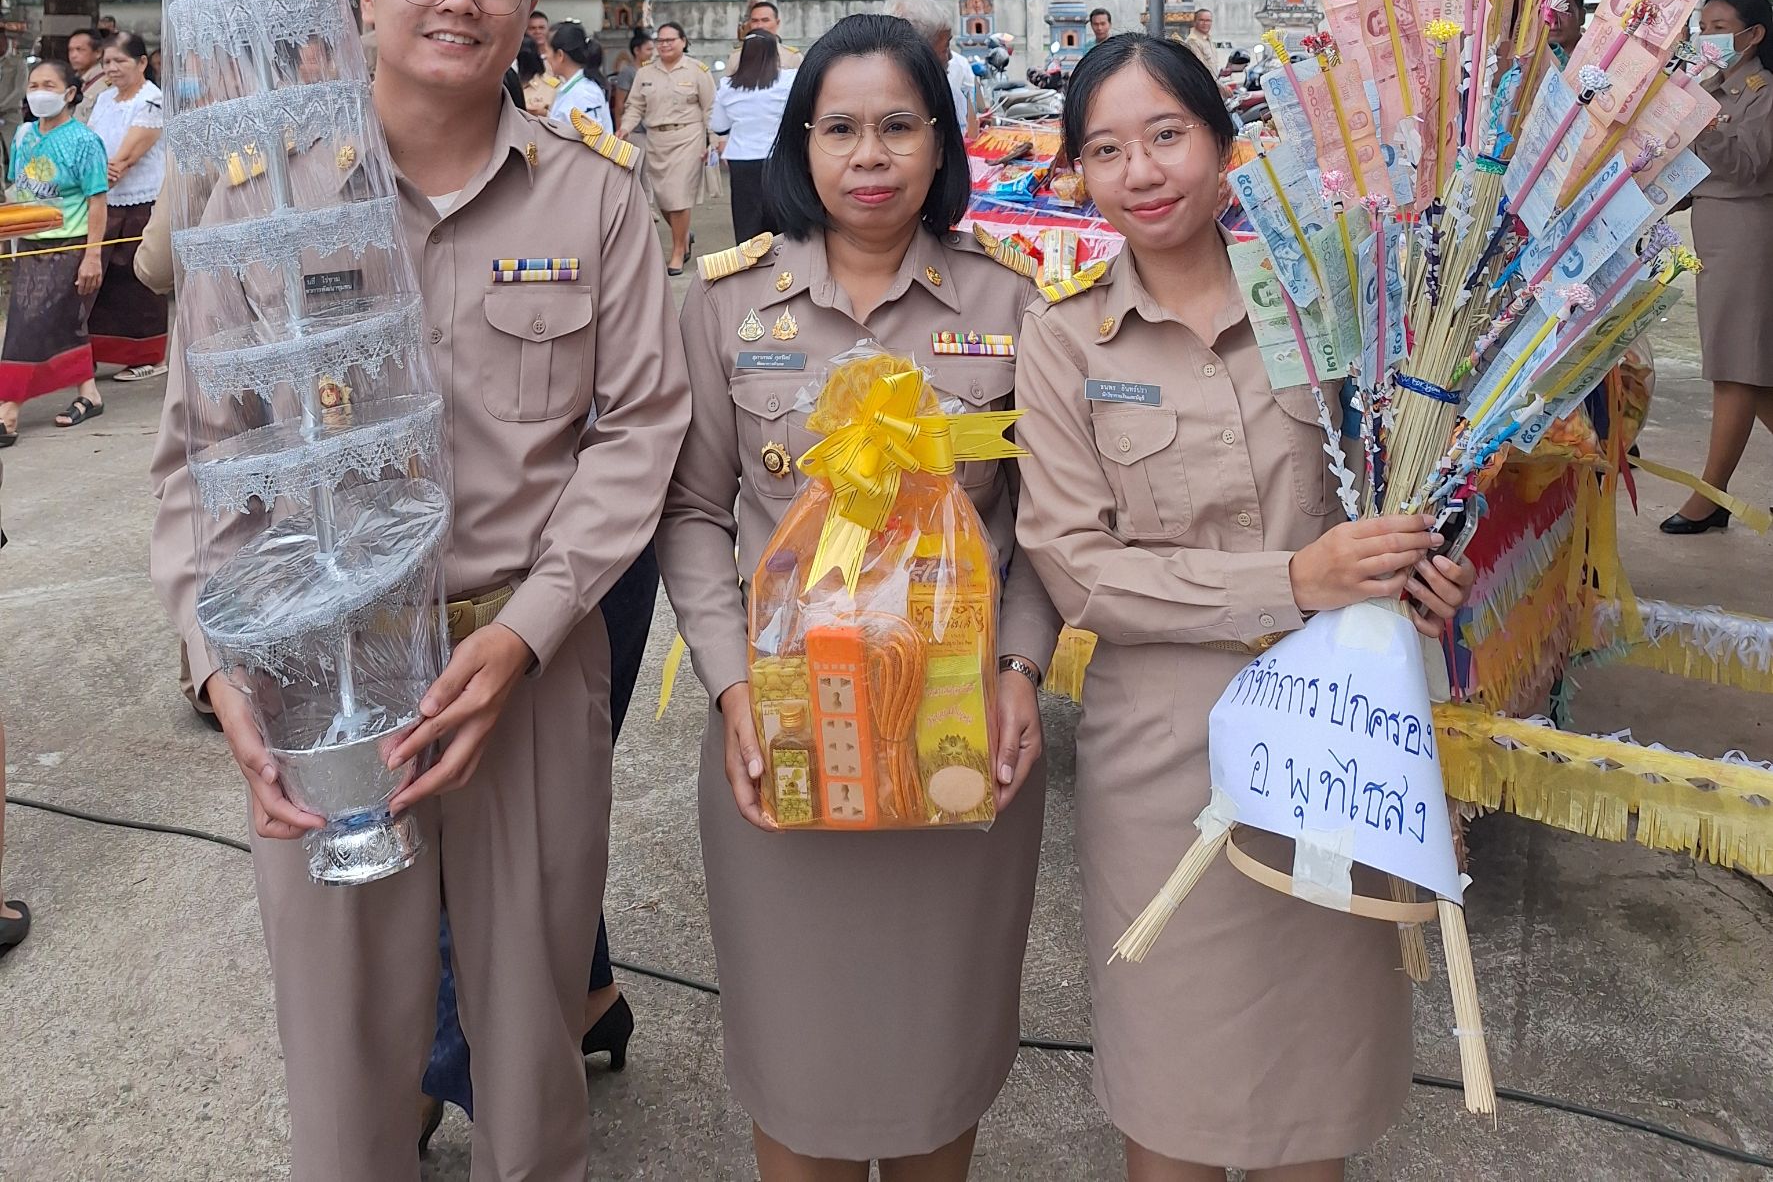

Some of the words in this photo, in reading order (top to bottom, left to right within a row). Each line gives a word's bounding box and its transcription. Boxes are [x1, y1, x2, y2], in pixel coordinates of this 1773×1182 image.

[1236, 173, 1253, 198] ๕๐
[1287, 278, 1299, 295] 50
[1521, 423, 1542, 444] ๕๐
